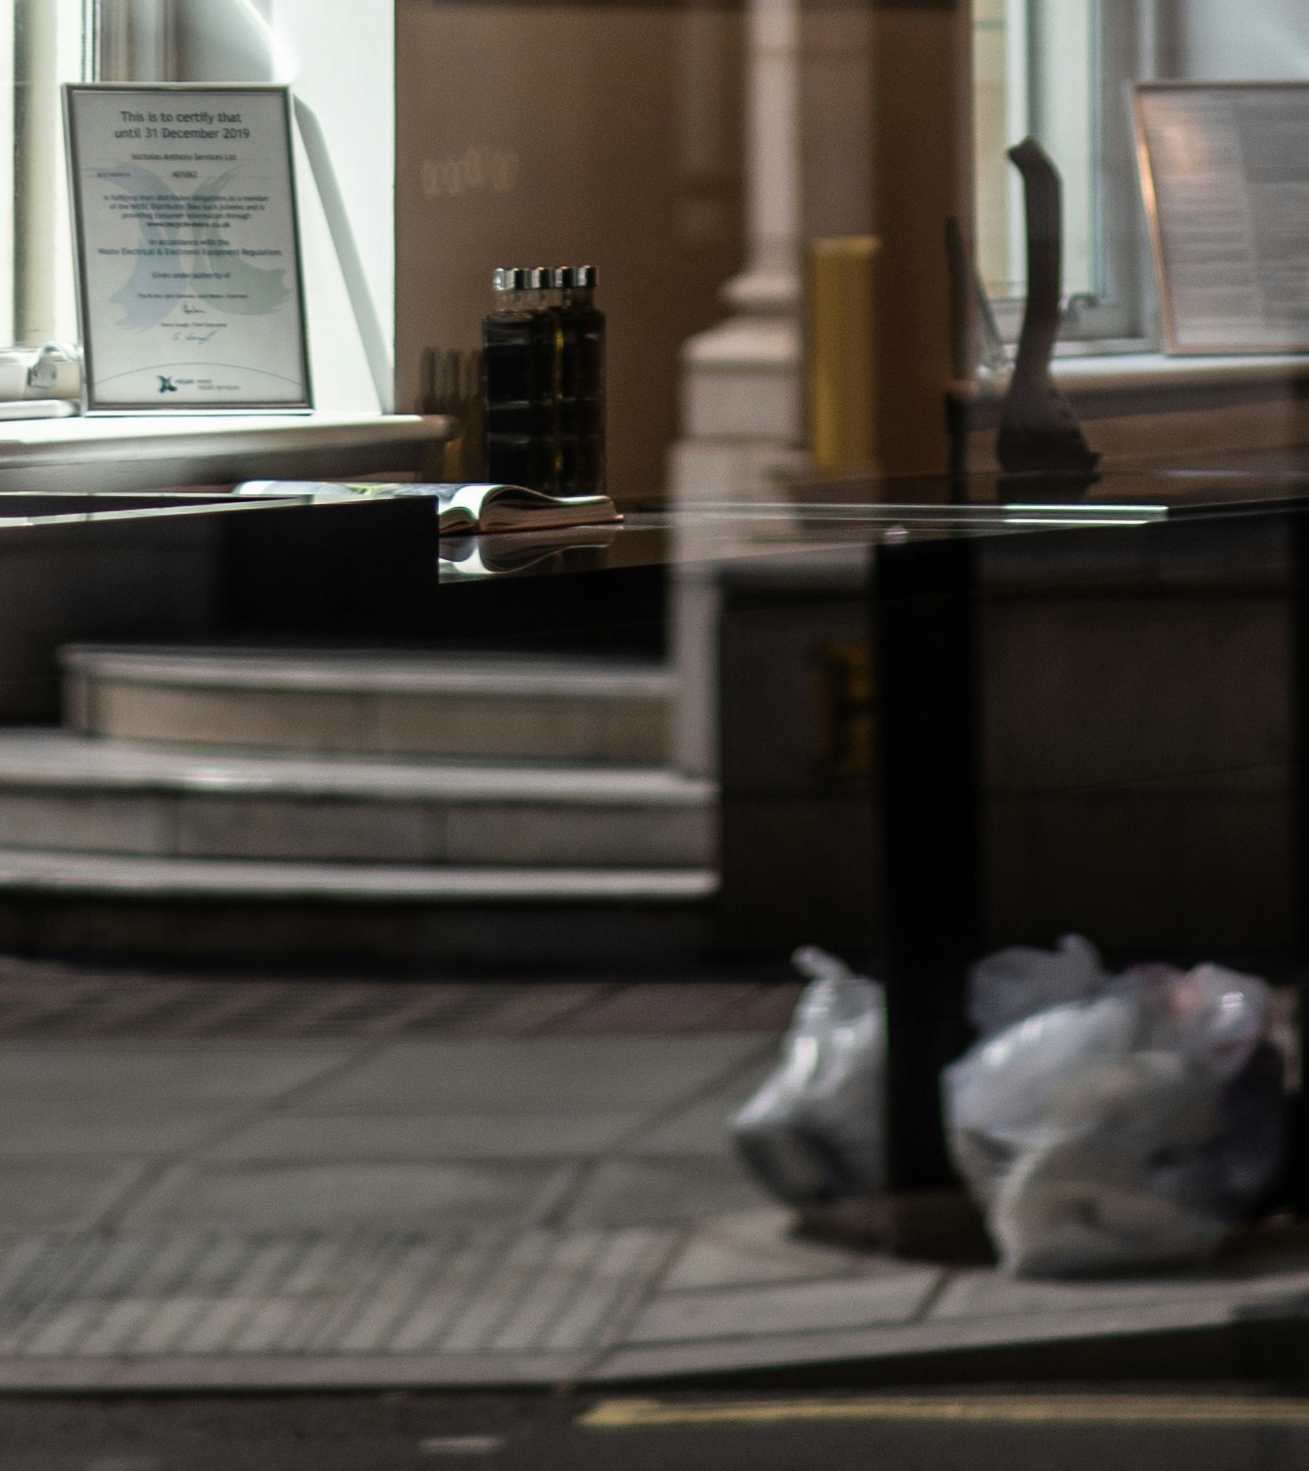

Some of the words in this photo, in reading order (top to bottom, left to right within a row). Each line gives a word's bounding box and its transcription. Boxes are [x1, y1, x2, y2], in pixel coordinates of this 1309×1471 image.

[120, 111, 145, 123] This
[148, 111, 158, 123] is
[161, 111, 173, 123] to
[176, 111, 214, 125] certify
[218, 111, 242, 123] that
[115, 127, 141, 139] until
[145, 127, 158, 139] 31
[162, 127, 219, 139] December
[223, 127, 250, 139] 2019
